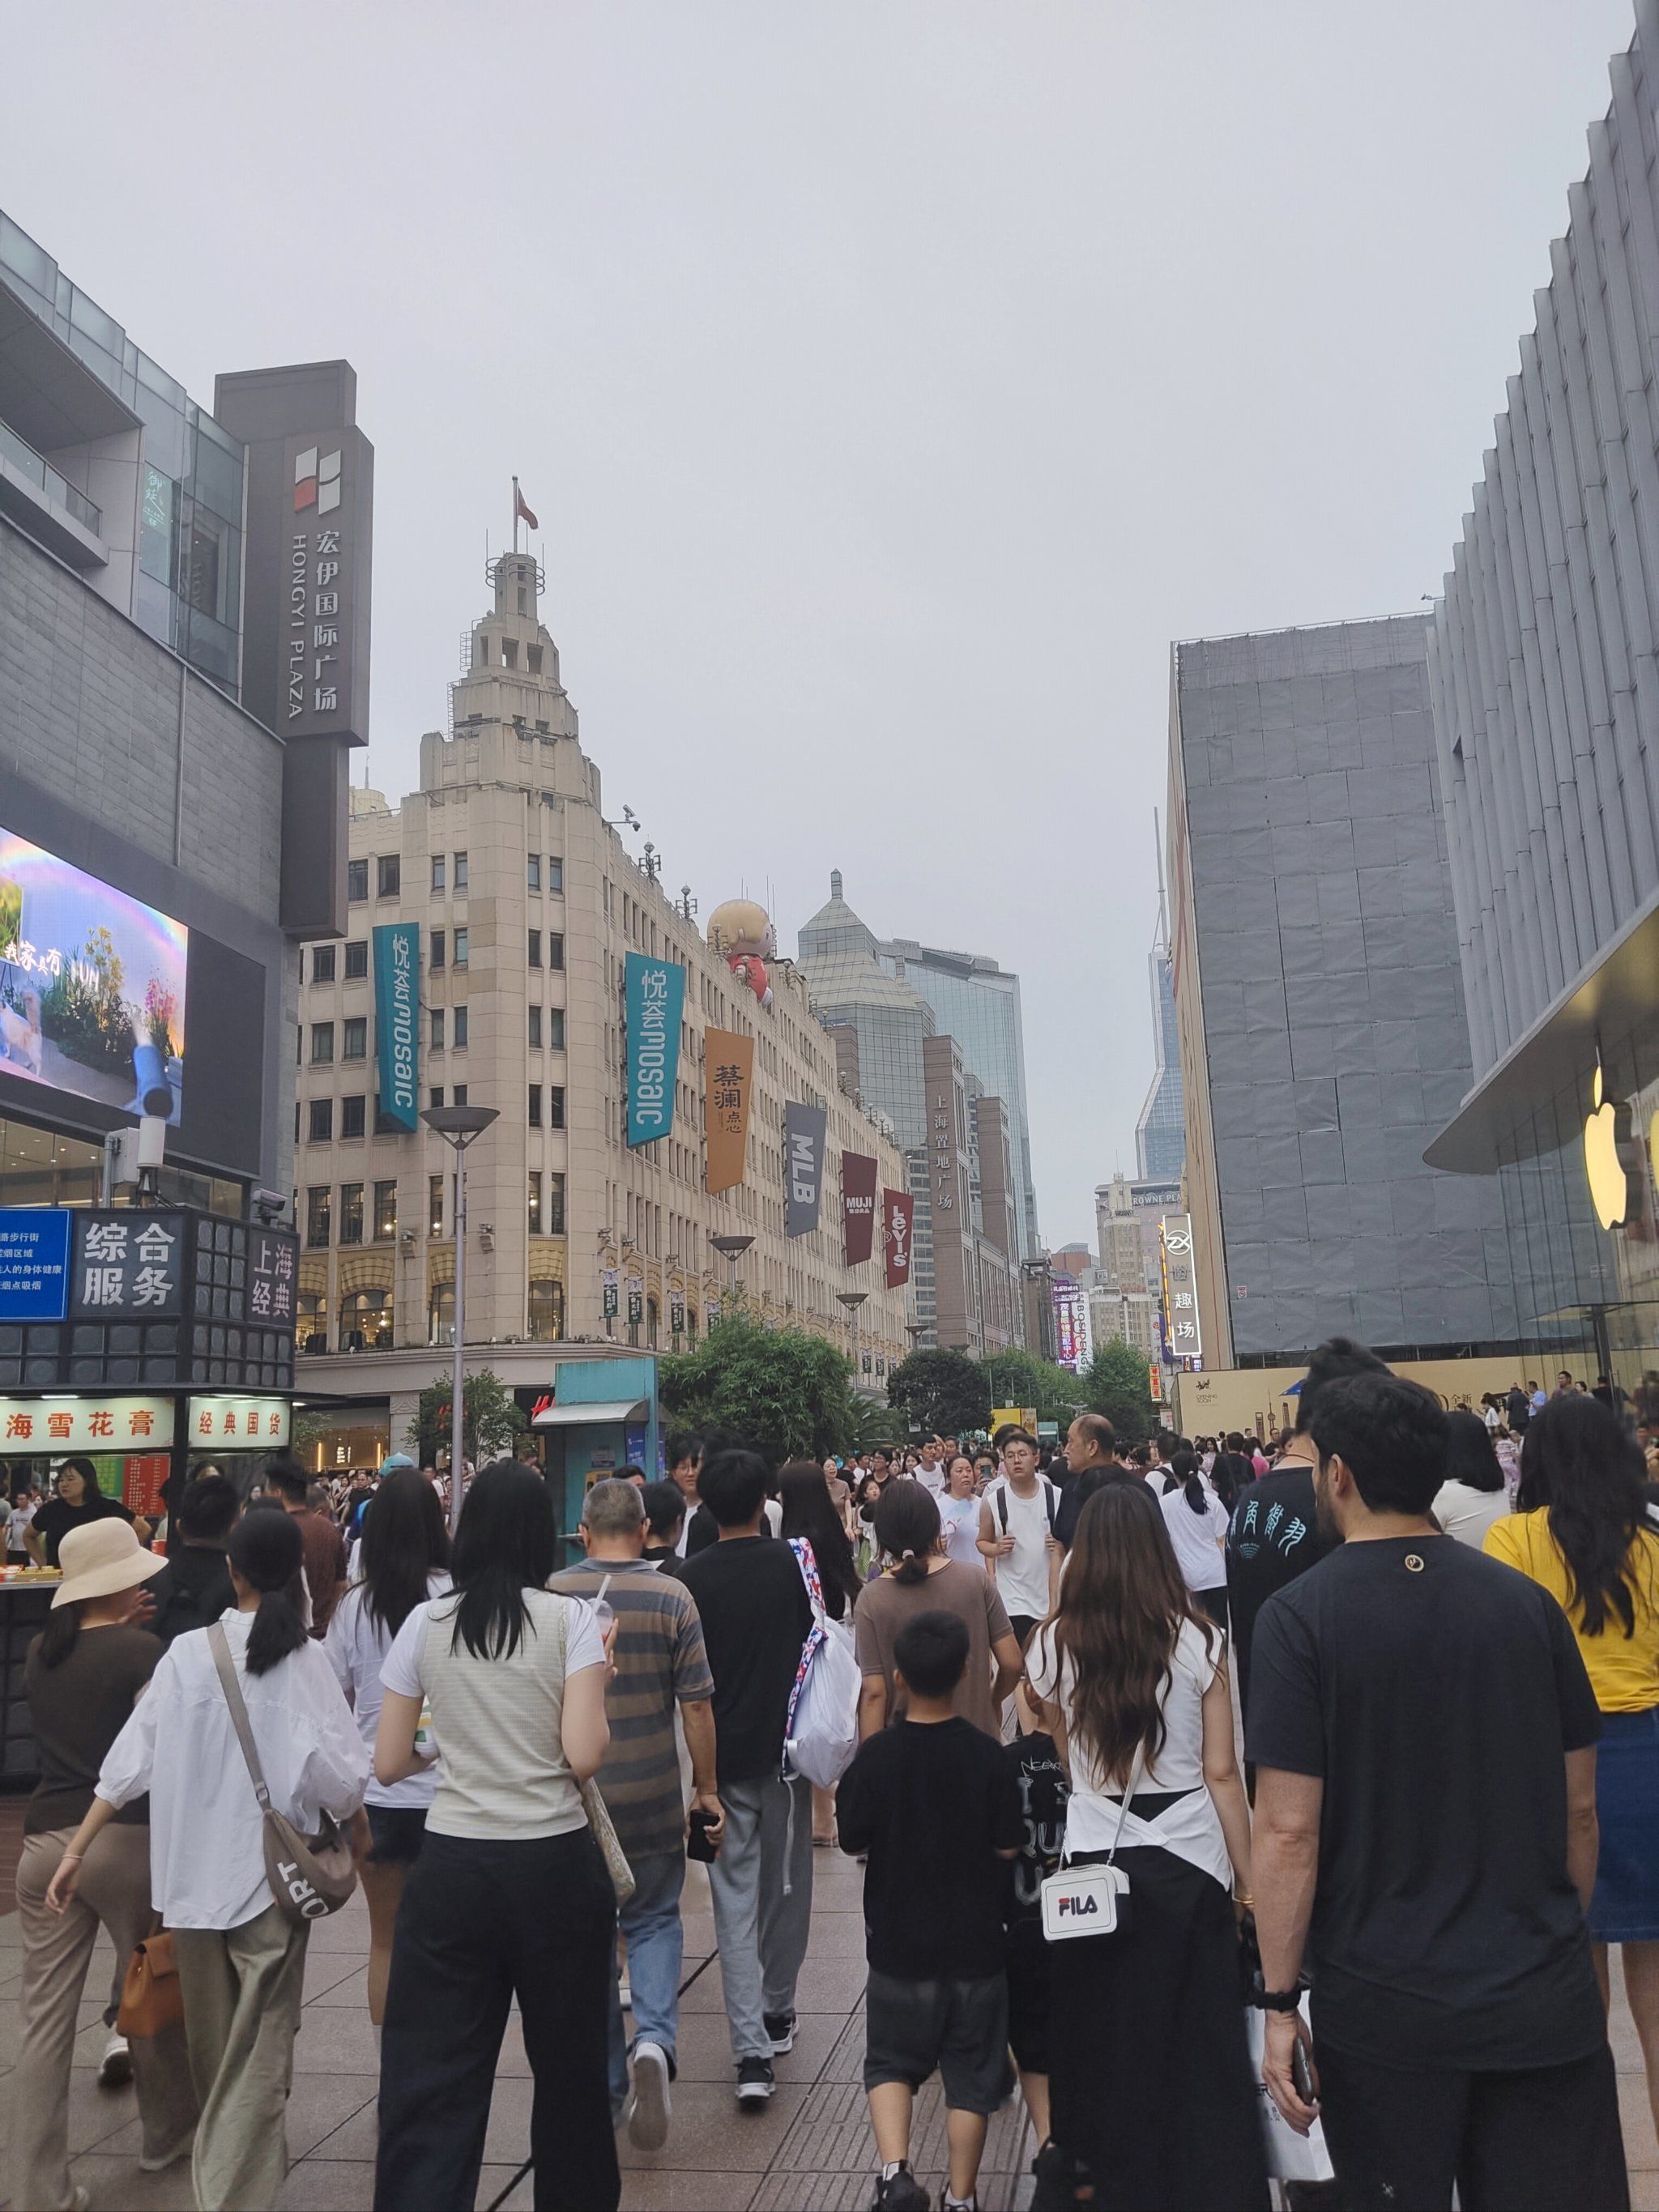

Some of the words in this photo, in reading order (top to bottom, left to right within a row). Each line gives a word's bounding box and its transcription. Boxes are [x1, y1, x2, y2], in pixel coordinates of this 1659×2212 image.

[292, 534, 307, 627] HONGYI
[313, 530, 339, 711] 宏伊国际广场
[288, 640, 305, 718] PLAZA
[642, 970, 667, 1029] 悦荟
[791, 1133, 816, 1204] MLB
[933, 1095, 953, 1210] 上海置地广场
[846, 1196, 872, 1208] MUJI
[1133, 1196, 1164, 1205] ROWNE
[1166, 1194, 1182, 1202] PLA
[84, 1222, 176, 1263] 综合
[254, 1240, 292, 1280] 上海
[0, 1281, 42, 1290] 烟点吸烟
[83, 1267, 173, 1306] 服务
[251, 1281, 291, 1319] 经典
[6, 1410, 155, 1439] 海雪花膏
[199, 1410, 281, 1436] 经典国货
[277, 1862, 329, 1918] ORT
[1059, 1894, 1098, 1916] FILA
